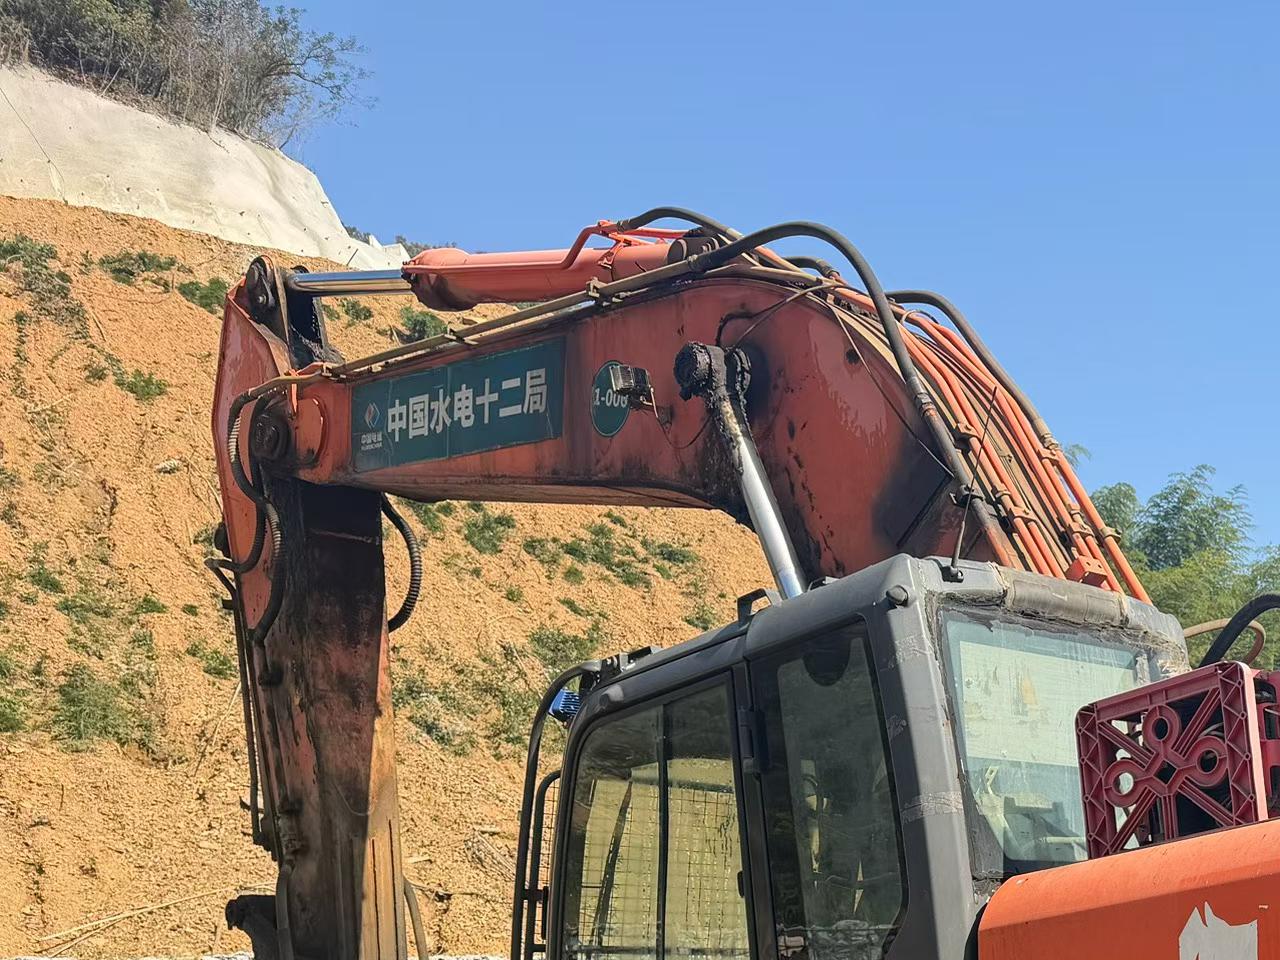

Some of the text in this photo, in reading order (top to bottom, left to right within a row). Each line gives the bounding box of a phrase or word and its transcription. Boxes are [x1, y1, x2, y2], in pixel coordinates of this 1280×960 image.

[387, 368, 547, 442] 中国水电十二局
